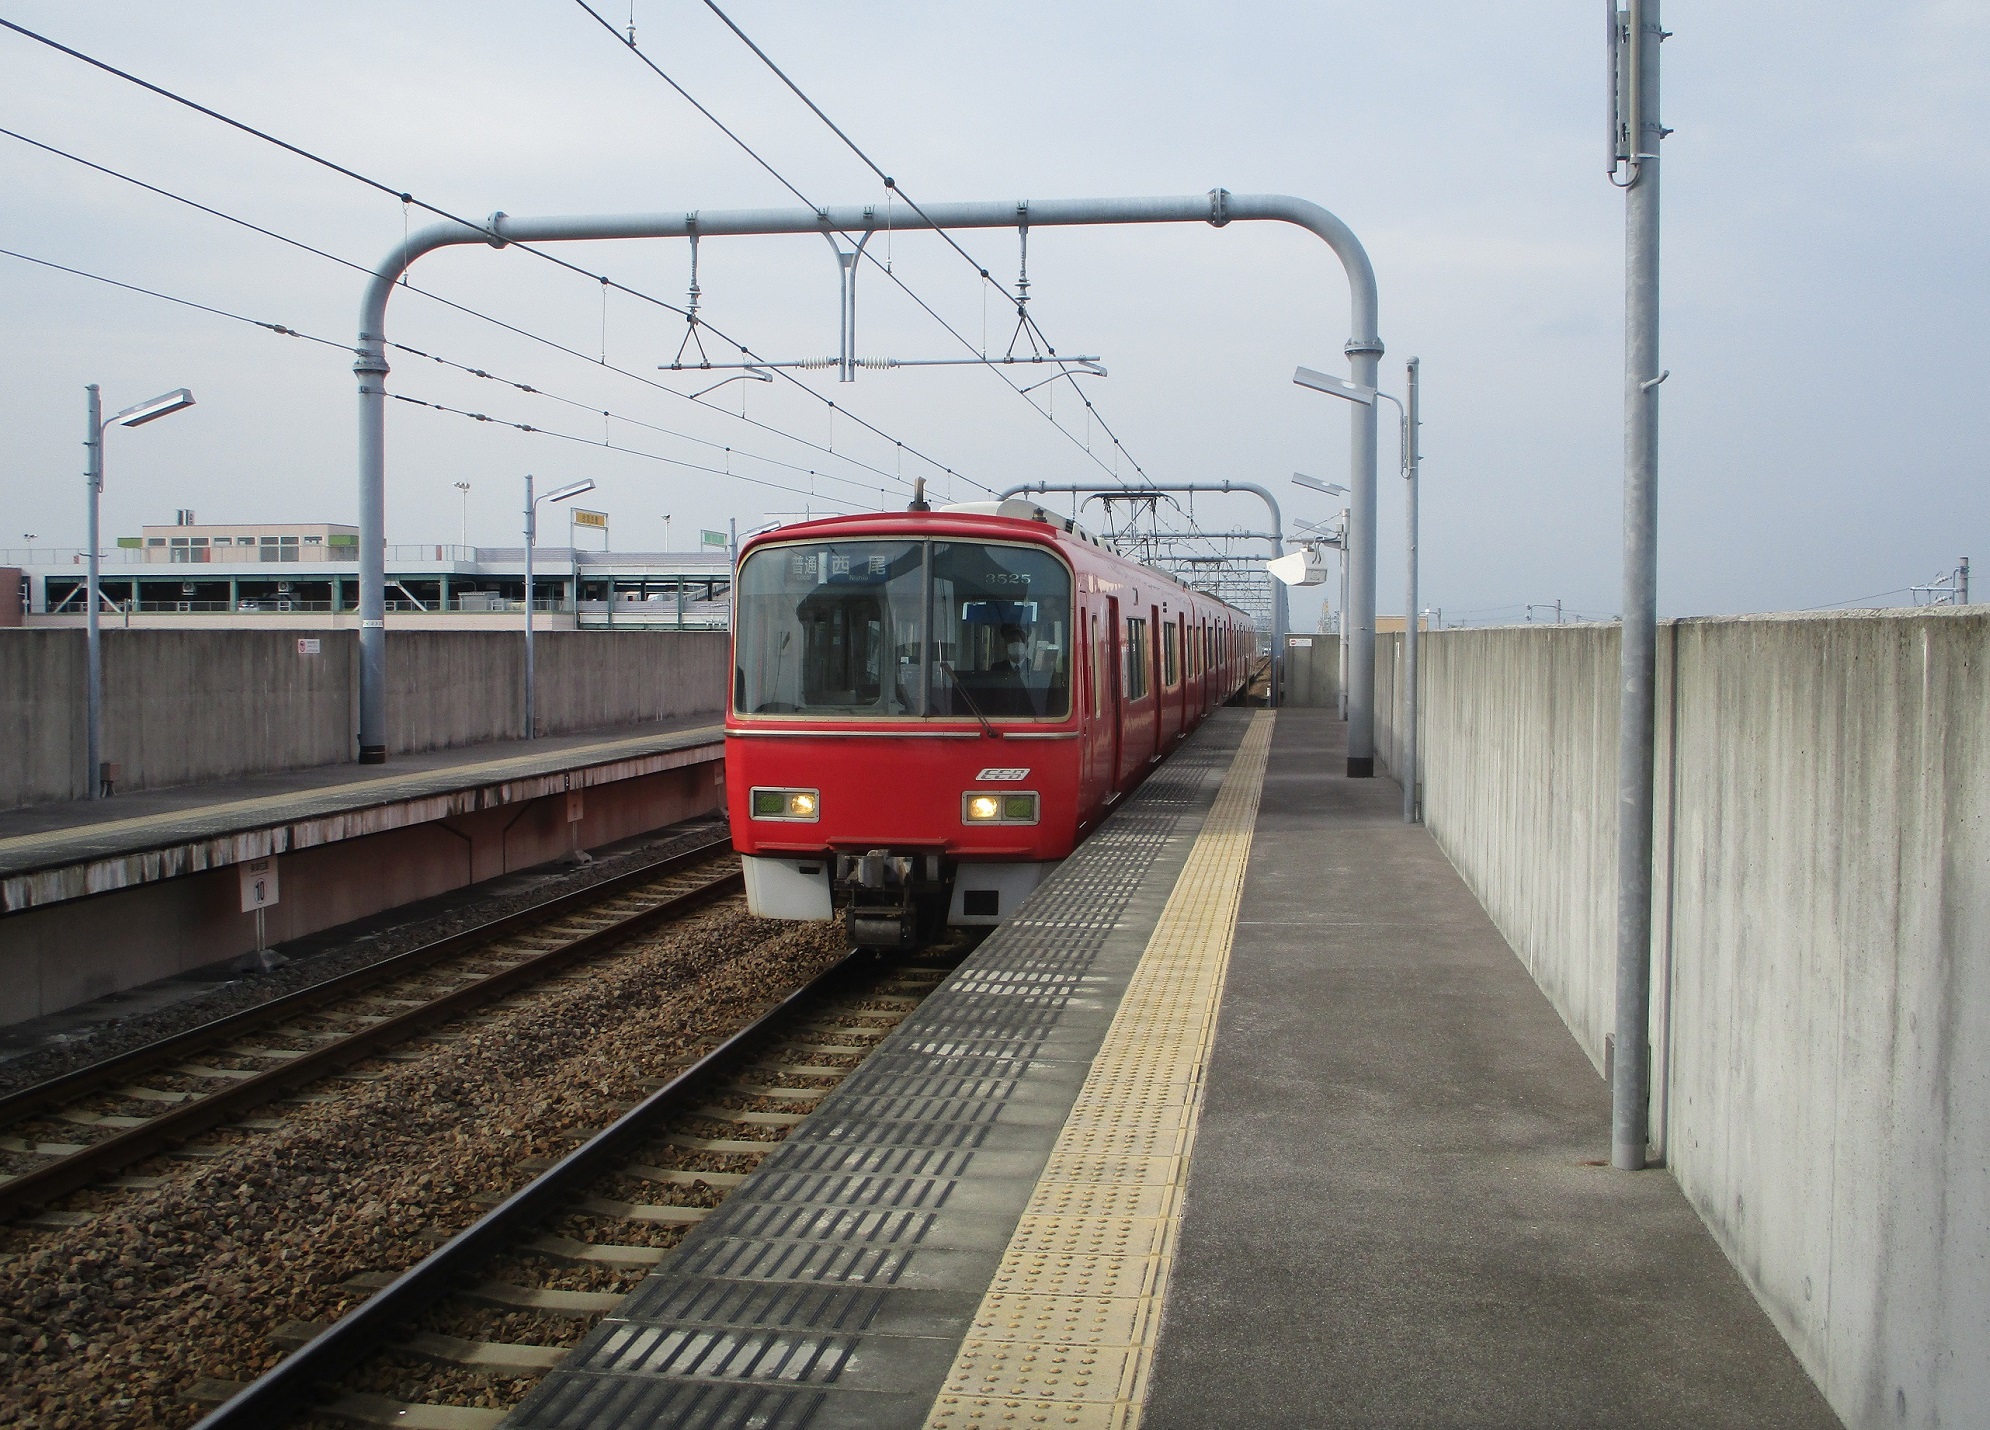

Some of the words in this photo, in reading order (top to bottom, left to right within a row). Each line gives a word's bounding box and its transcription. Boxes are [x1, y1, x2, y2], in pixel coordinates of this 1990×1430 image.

[792, 555, 818, 575] 普通
[985, 573, 1031, 585] 3525
[255, 880, 265, 901] 10
